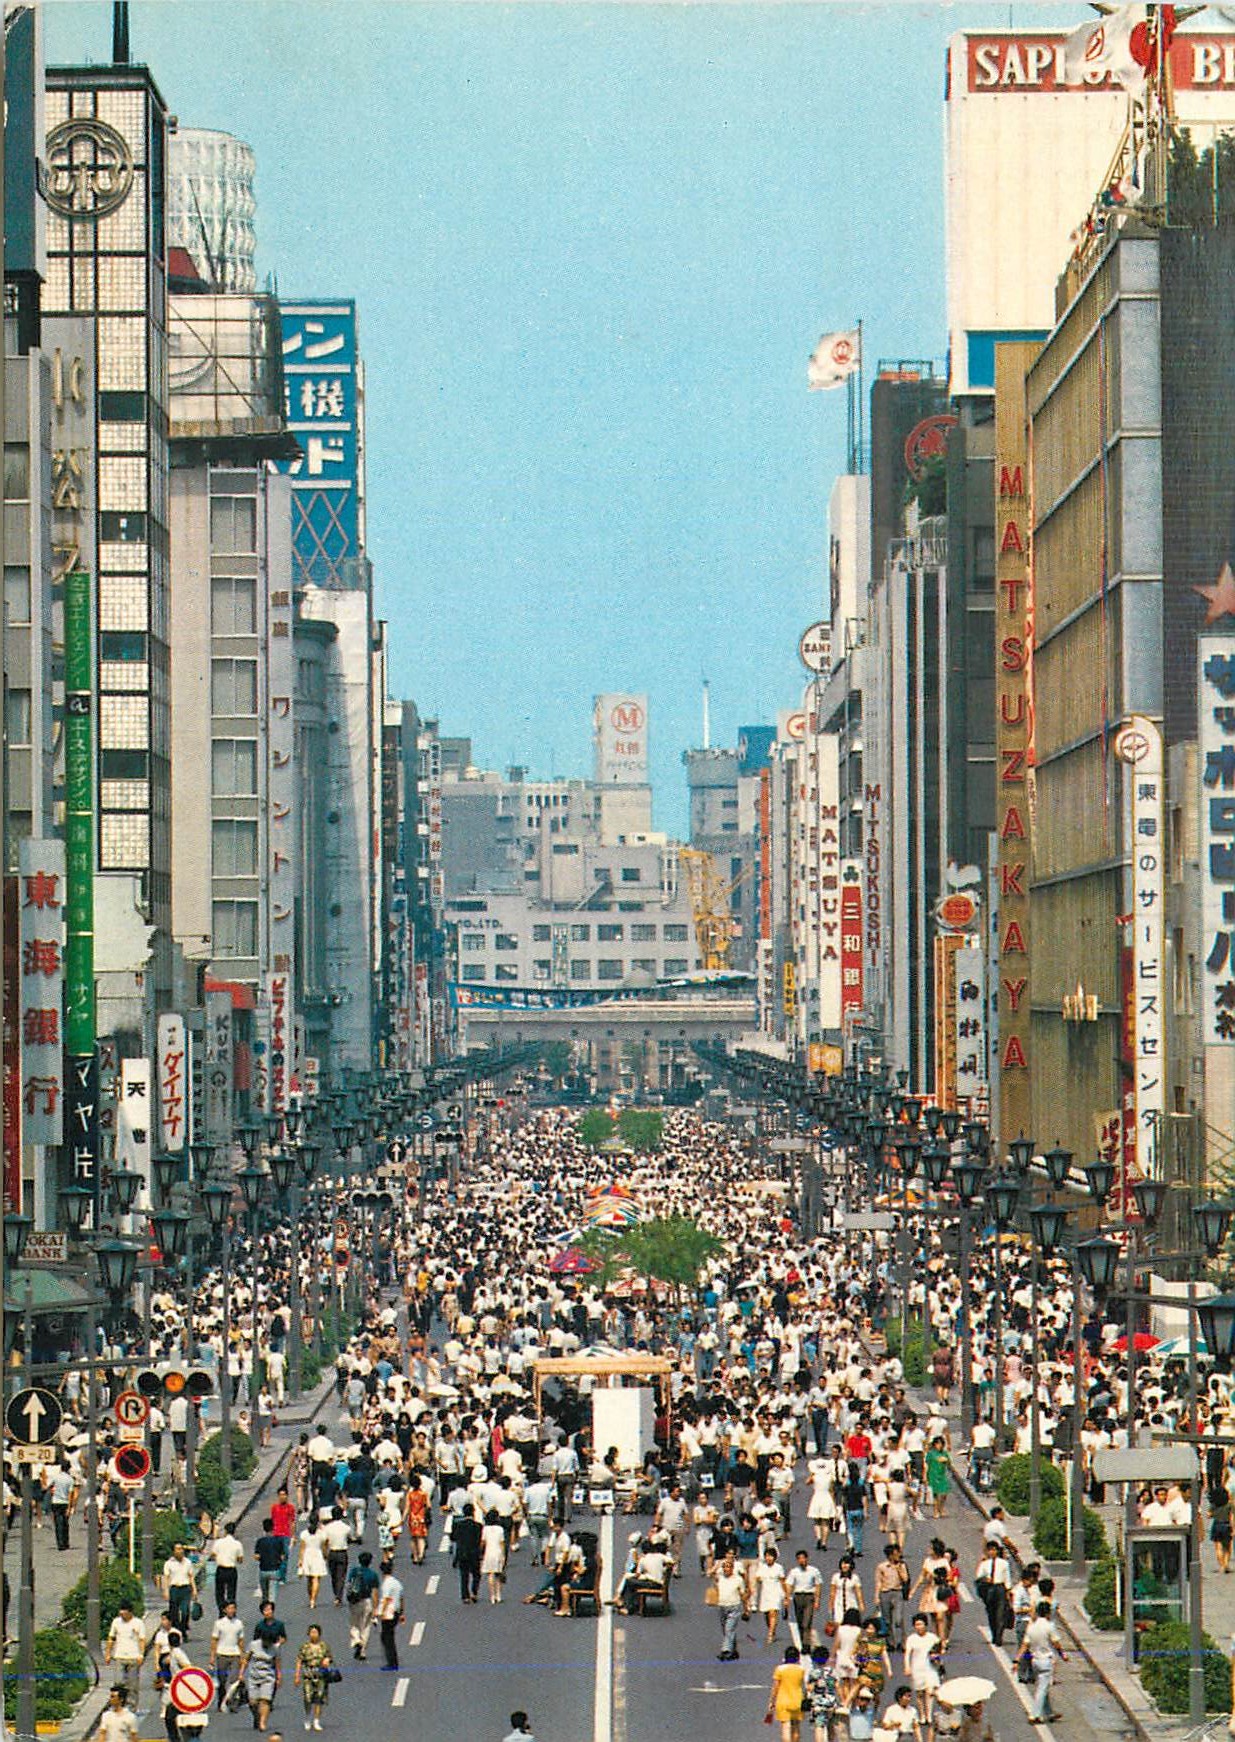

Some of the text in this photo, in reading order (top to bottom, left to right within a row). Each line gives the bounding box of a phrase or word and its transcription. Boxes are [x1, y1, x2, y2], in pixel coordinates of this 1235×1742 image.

[284, 379, 345, 417] 機
[1000, 465, 1028, 1069] MATSUZAKAYA
[822, 806, 838, 960] MATSUYA
[865, 784, 881, 966] MITSUKOSHI
[22, 870, 61, 1115] 東海銀行
[162, 1050, 184, 1137] ダイアナ
